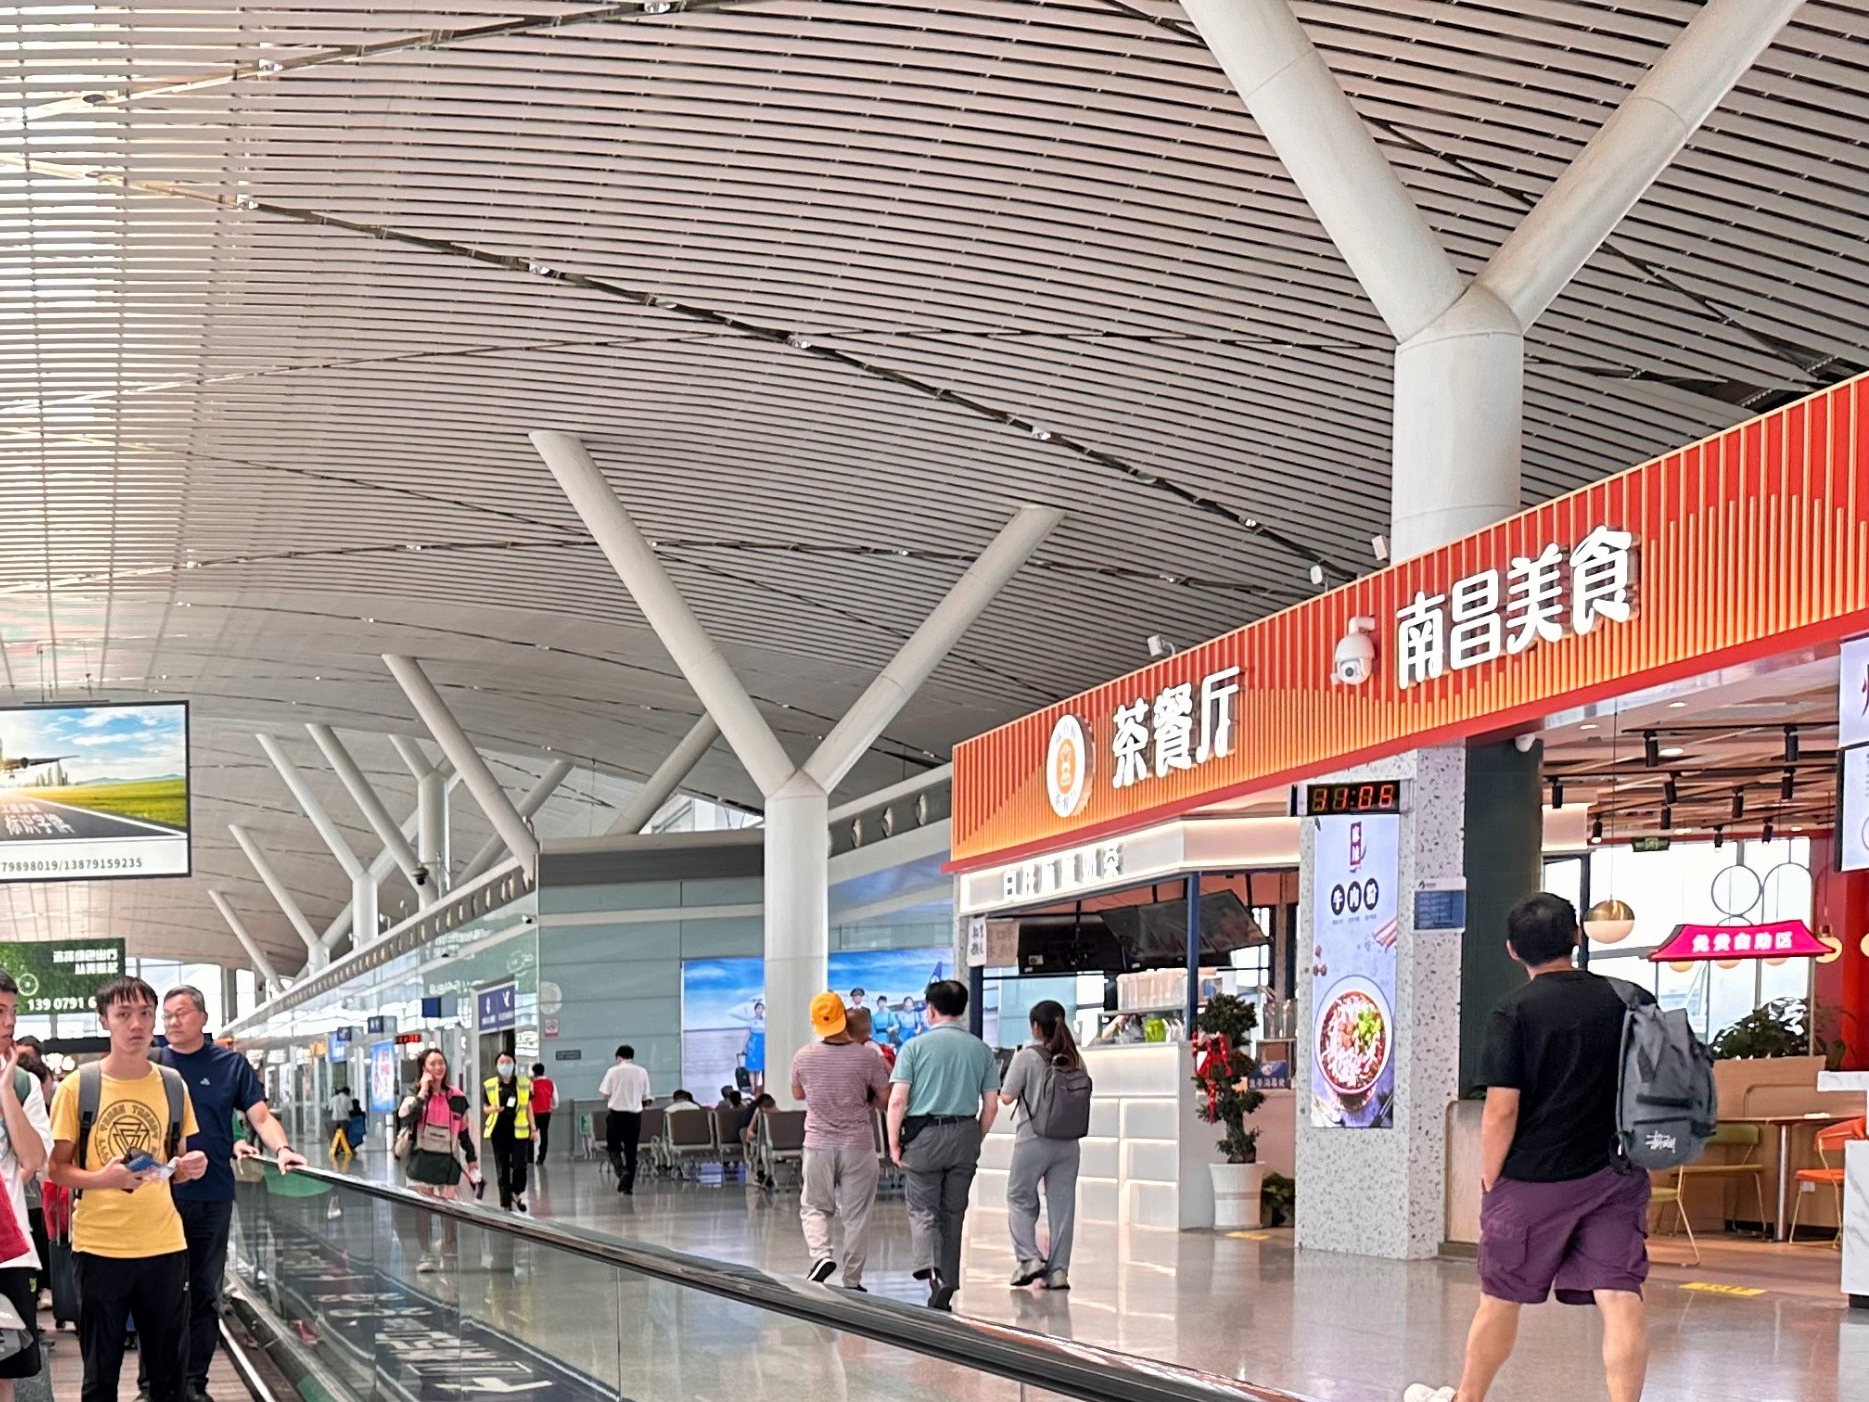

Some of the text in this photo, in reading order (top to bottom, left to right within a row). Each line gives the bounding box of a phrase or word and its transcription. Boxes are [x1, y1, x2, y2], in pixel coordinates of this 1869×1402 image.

[1396, 525, 1632, 689] 南昌美食
[1112, 666, 1240, 789] 茶餐厅
[27, 998, 50, 1011] 139
[53, 996, 84, 1010] 0791
